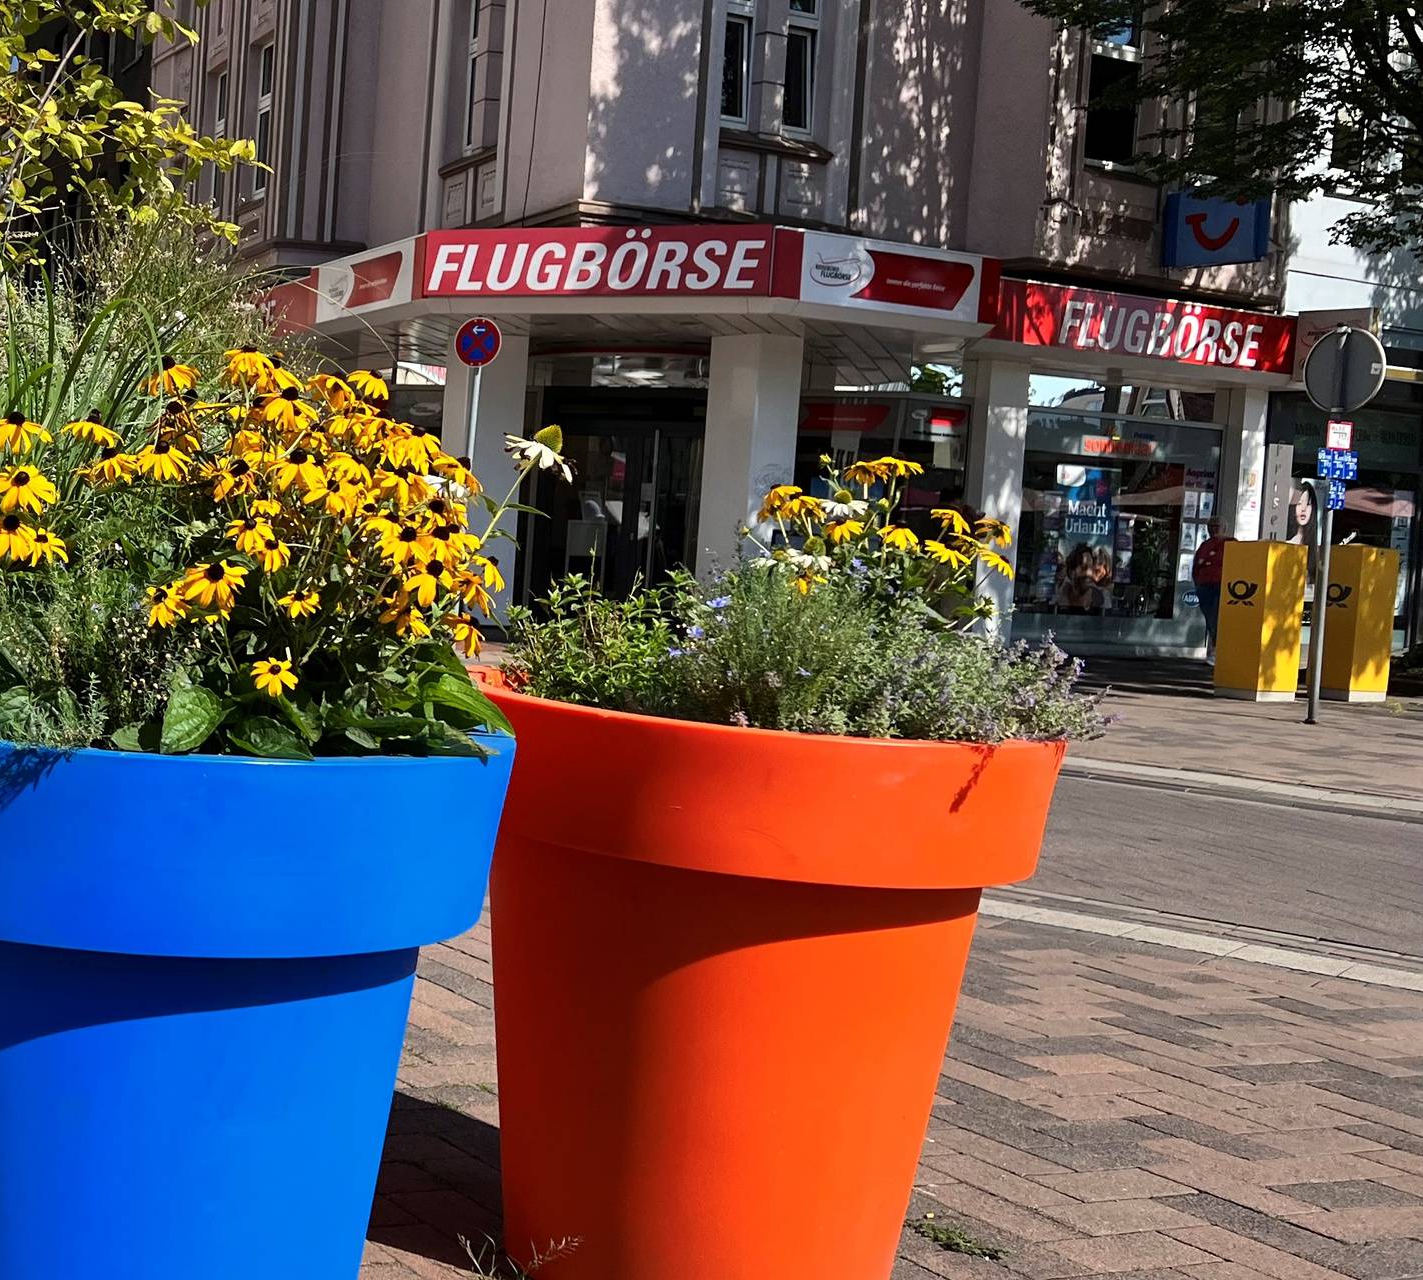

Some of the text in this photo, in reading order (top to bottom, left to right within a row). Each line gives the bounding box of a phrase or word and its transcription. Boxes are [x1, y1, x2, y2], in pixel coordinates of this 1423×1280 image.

[427, 228, 767, 291] FLUGBÖRSE
[820, 270, 852, 281] FLUGBÖRSE
[1058, 301, 1264, 369] FLUGBÖRSE
[1068, 500, 1107, 518] Macht
[1065, 517, 1109, 536] Urlaub!
